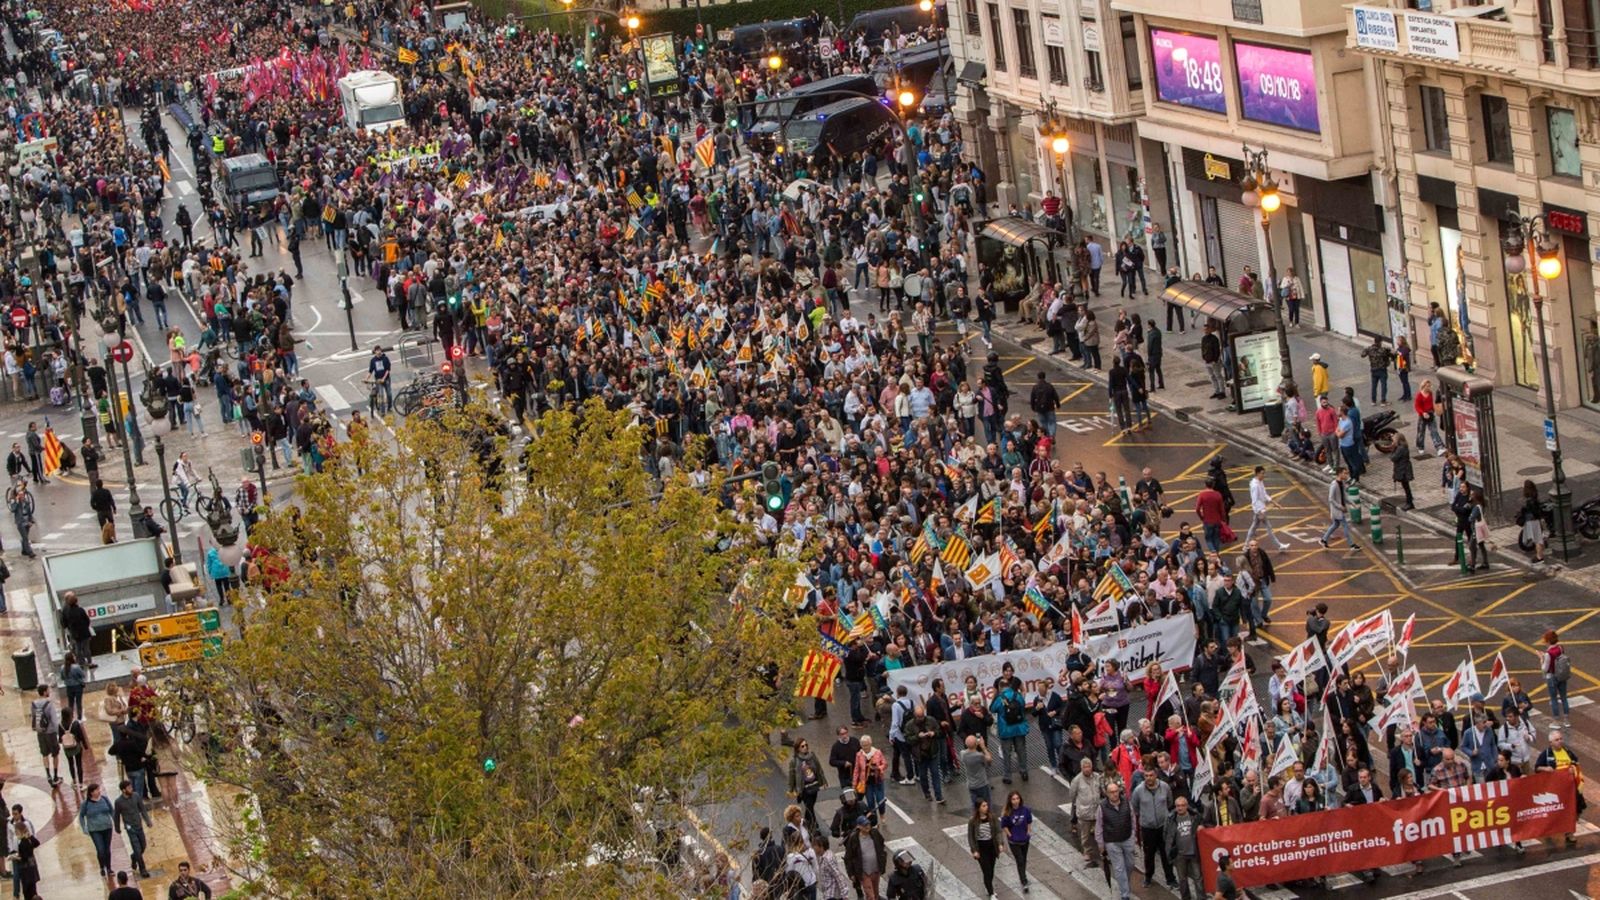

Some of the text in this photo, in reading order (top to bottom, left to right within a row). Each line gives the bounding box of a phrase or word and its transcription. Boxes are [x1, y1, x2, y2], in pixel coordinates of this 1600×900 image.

[1409, 26, 1437, 35] IMPLANTES
[1432, 19, 1452, 27] DENTAL
[1432, 38, 1448, 46] BUCAL
[1184, 56, 1224, 94] 18:48
[1259, 73, 1301, 101] 09/10/18
[1549, 210, 1583, 234] GUESS
[1450, 800, 1511, 833] País
[1516, 803, 1565, 818] INTERSINDICAL
[1233, 839, 1296, 856] d'Octubre:
[1299, 829, 1353, 847] guanyem
[1393, 816, 1446, 845] fem
[1233, 836, 1390, 869] drets, guanyem llibertats,
